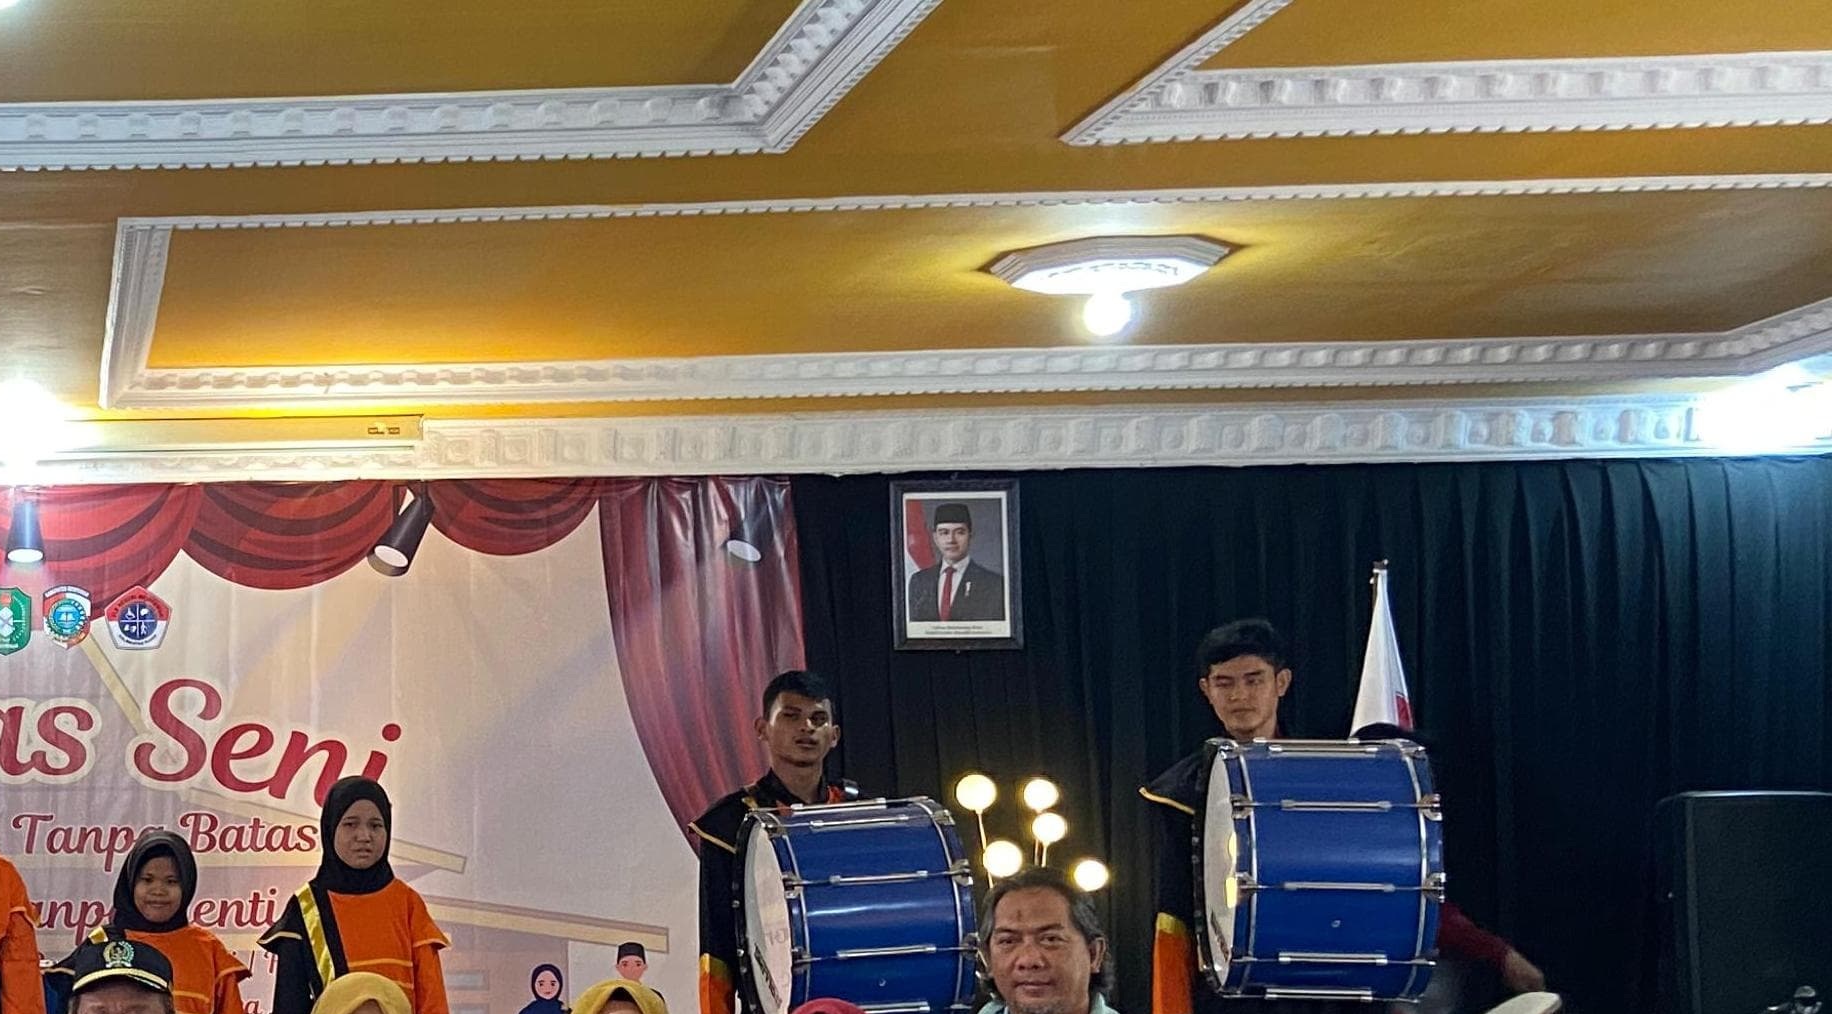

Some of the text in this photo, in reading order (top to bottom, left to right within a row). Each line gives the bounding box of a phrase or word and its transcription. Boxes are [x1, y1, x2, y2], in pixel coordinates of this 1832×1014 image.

[133, 678, 403, 807] Seni
[179, 811, 319, 854] Batas
[191, 888, 277, 928] enti
